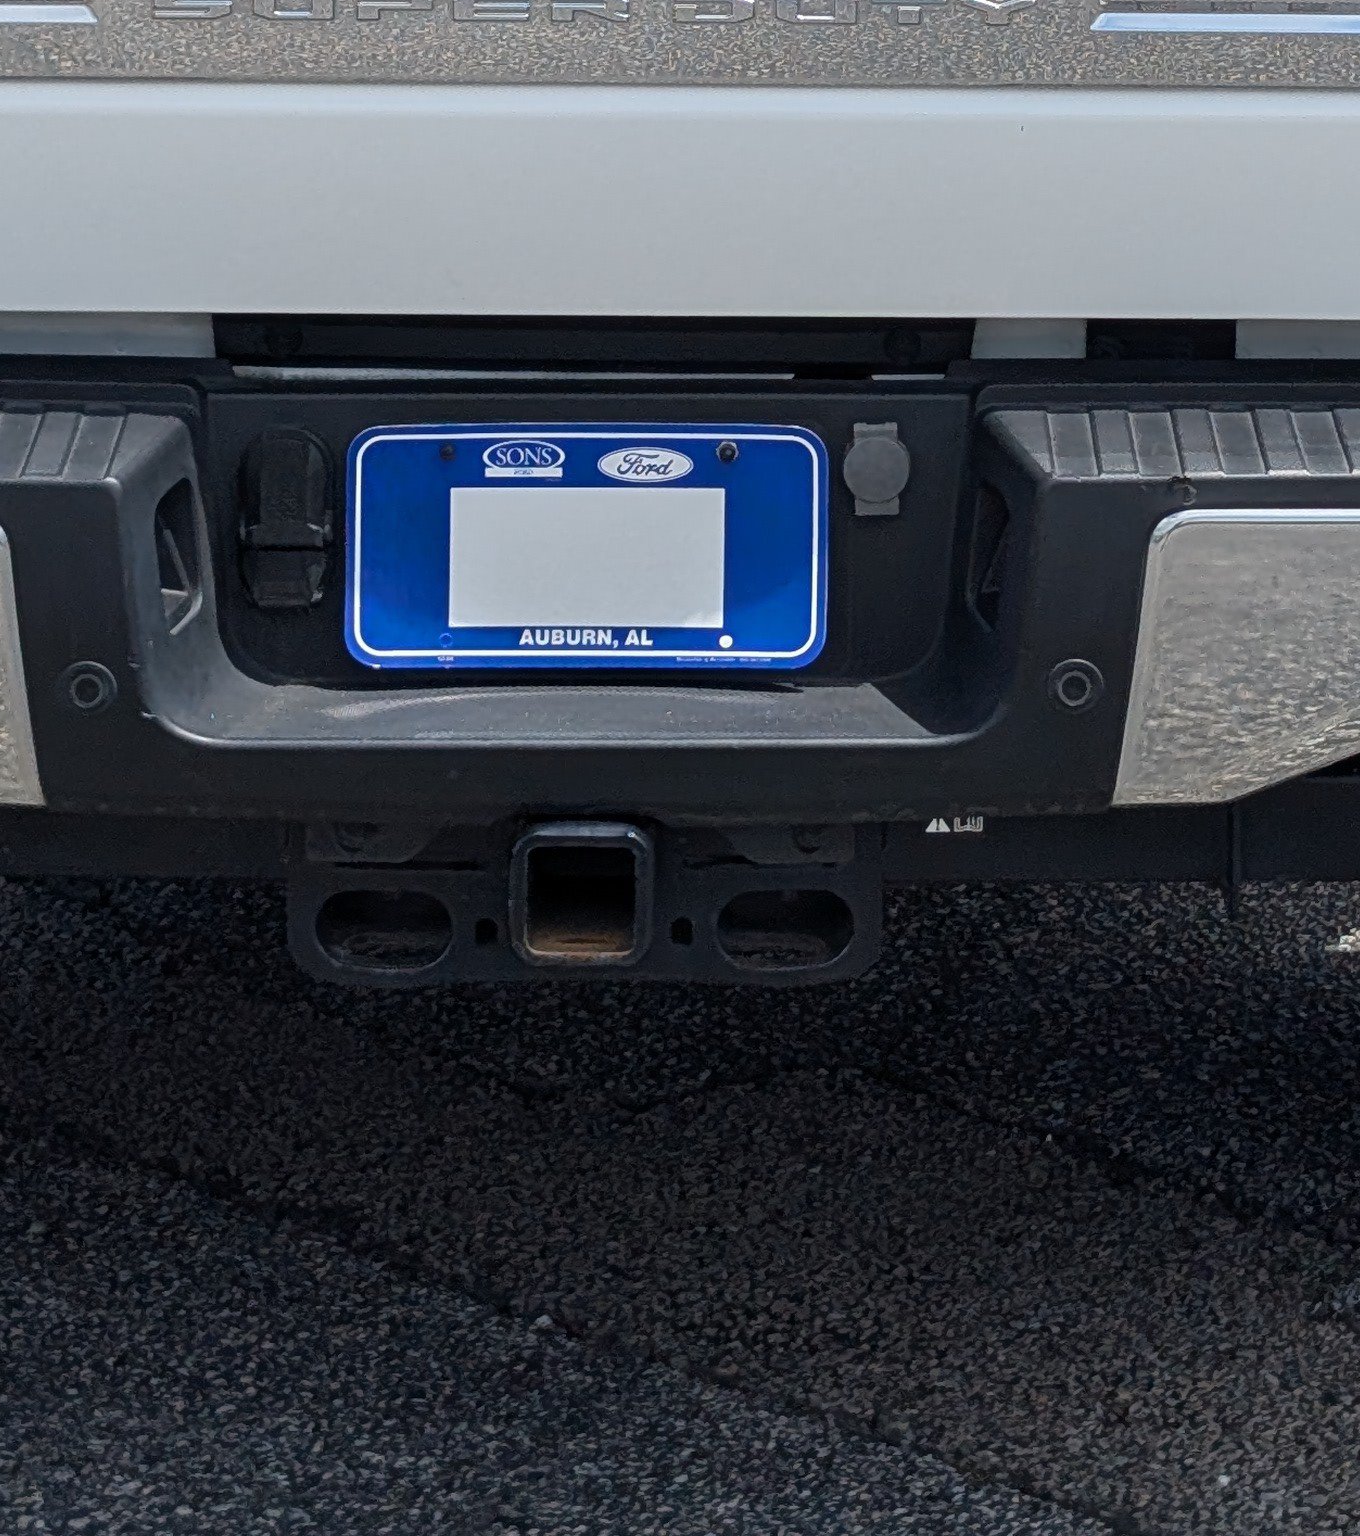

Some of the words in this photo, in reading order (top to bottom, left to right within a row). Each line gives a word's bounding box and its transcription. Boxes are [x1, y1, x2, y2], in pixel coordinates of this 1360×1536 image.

[496, 447, 553, 466] SONS
[616, 452, 674, 477] Ford
[519, 629, 619, 649] AUBURN,
[624, 629, 654, 647] AL
